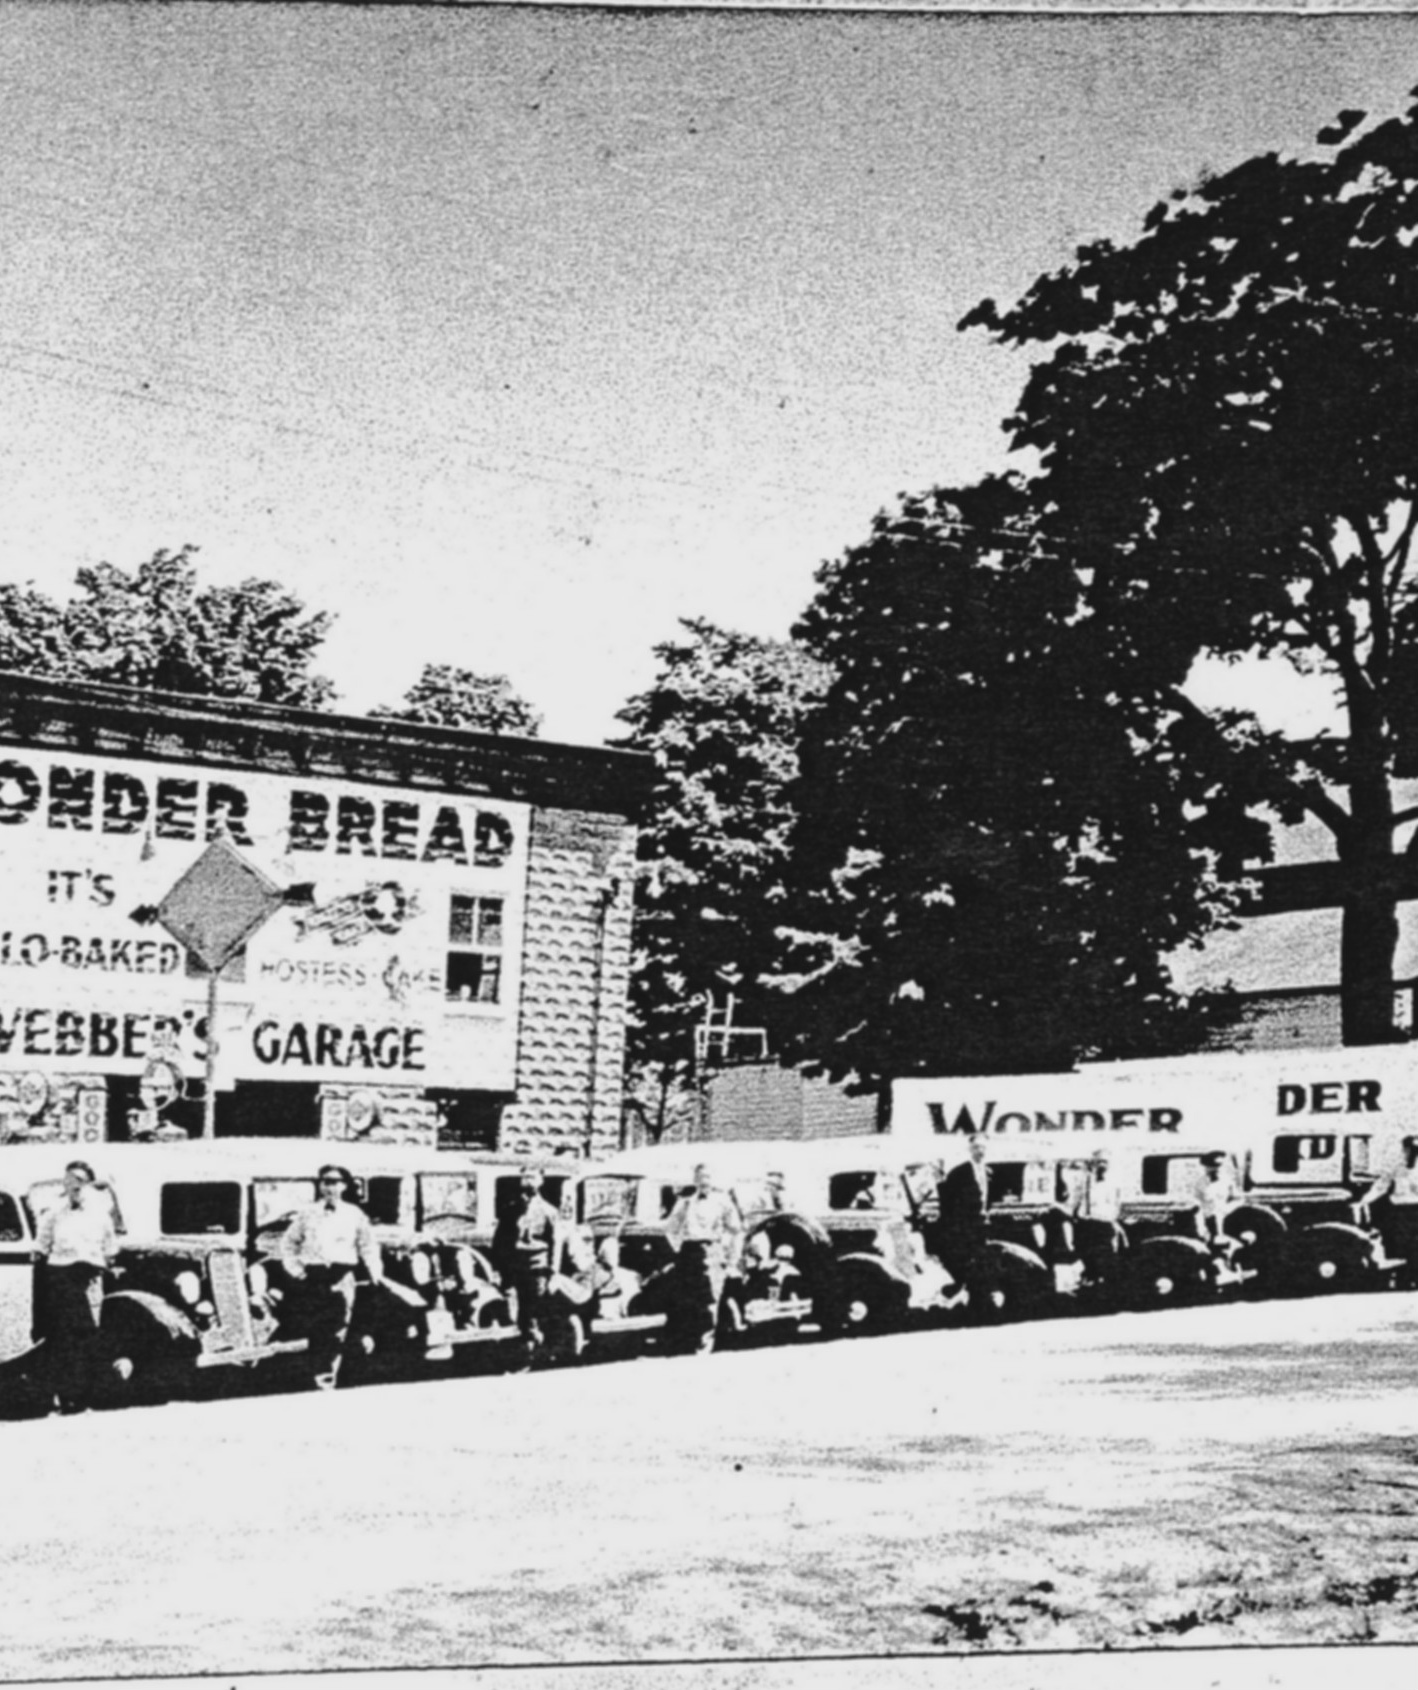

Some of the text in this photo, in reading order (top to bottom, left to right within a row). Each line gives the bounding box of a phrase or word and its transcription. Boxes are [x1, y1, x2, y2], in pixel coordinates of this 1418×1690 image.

[290, 790, 515, 867] BREAD
[46, 868, 117, 907] IT'S
[260, 956, 367, 988] HOSTESS
[252, 1019, 427, 1072] GARAGE
[1276, 1078, 1383, 1117] DER
